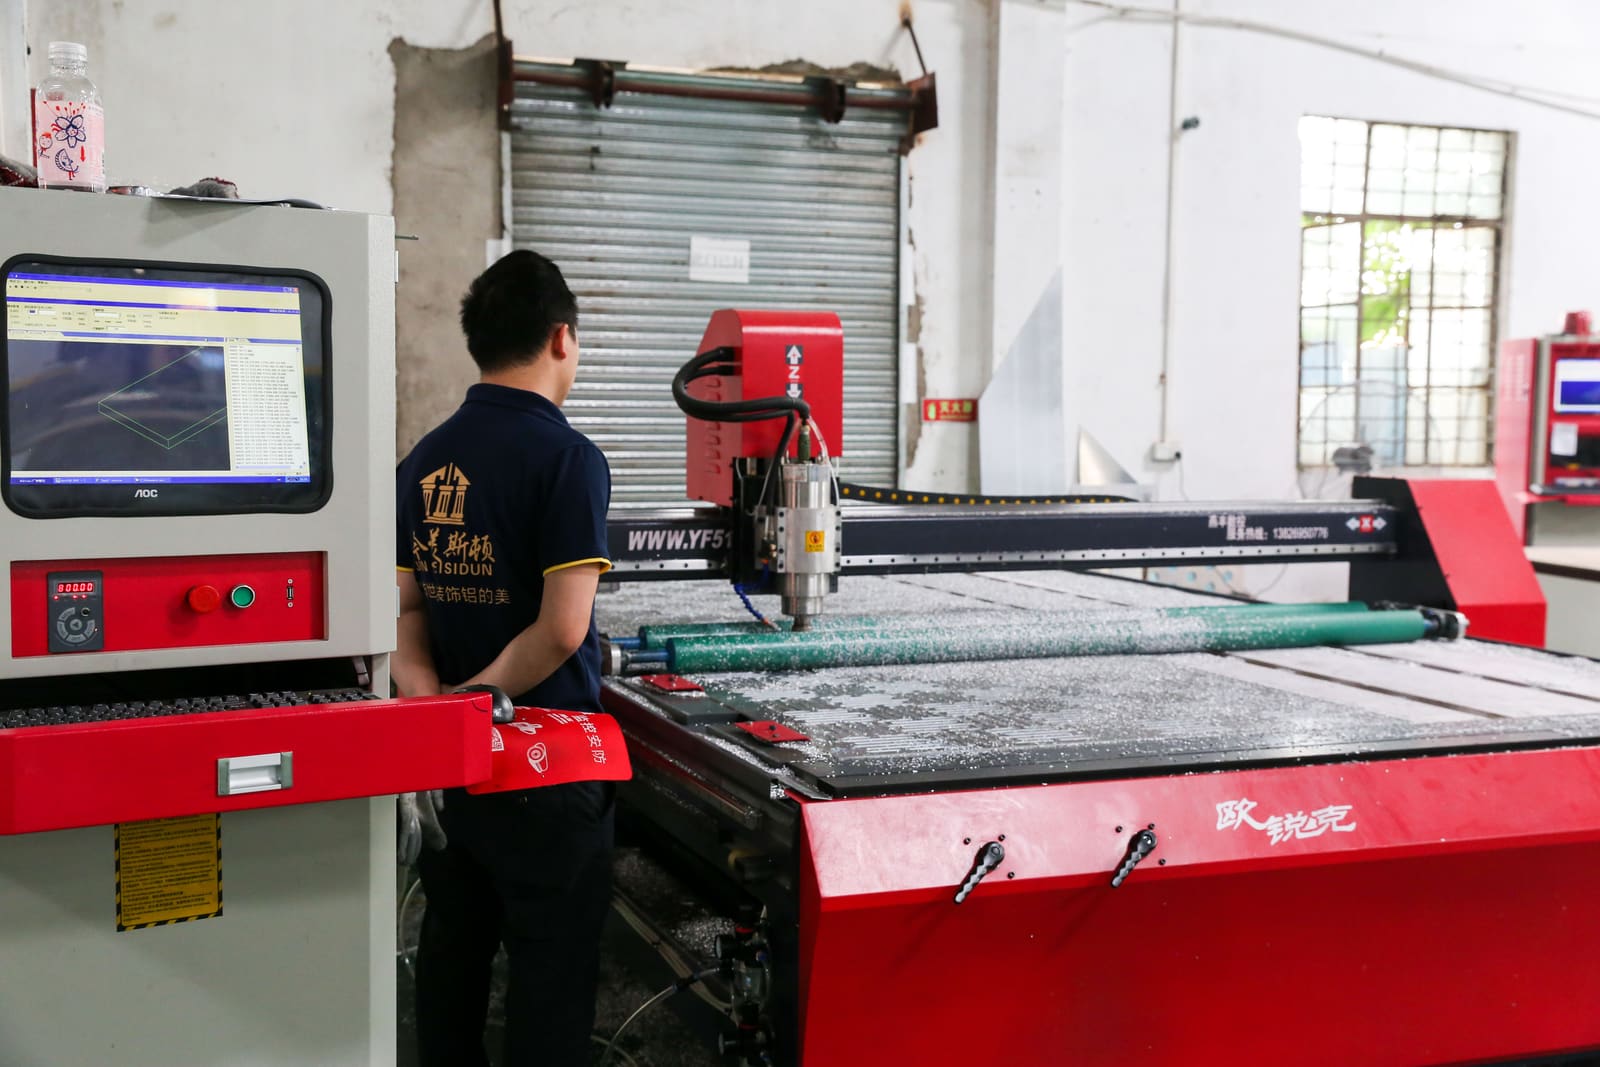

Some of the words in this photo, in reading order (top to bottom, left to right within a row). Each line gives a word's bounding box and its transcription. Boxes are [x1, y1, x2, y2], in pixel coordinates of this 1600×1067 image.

[788, 366, 800, 379] Z
[134, 489, 158, 498] AOC
[1361, 517, 1371, 529] X
[1215, 797, 1357, 846] 欧锐克
